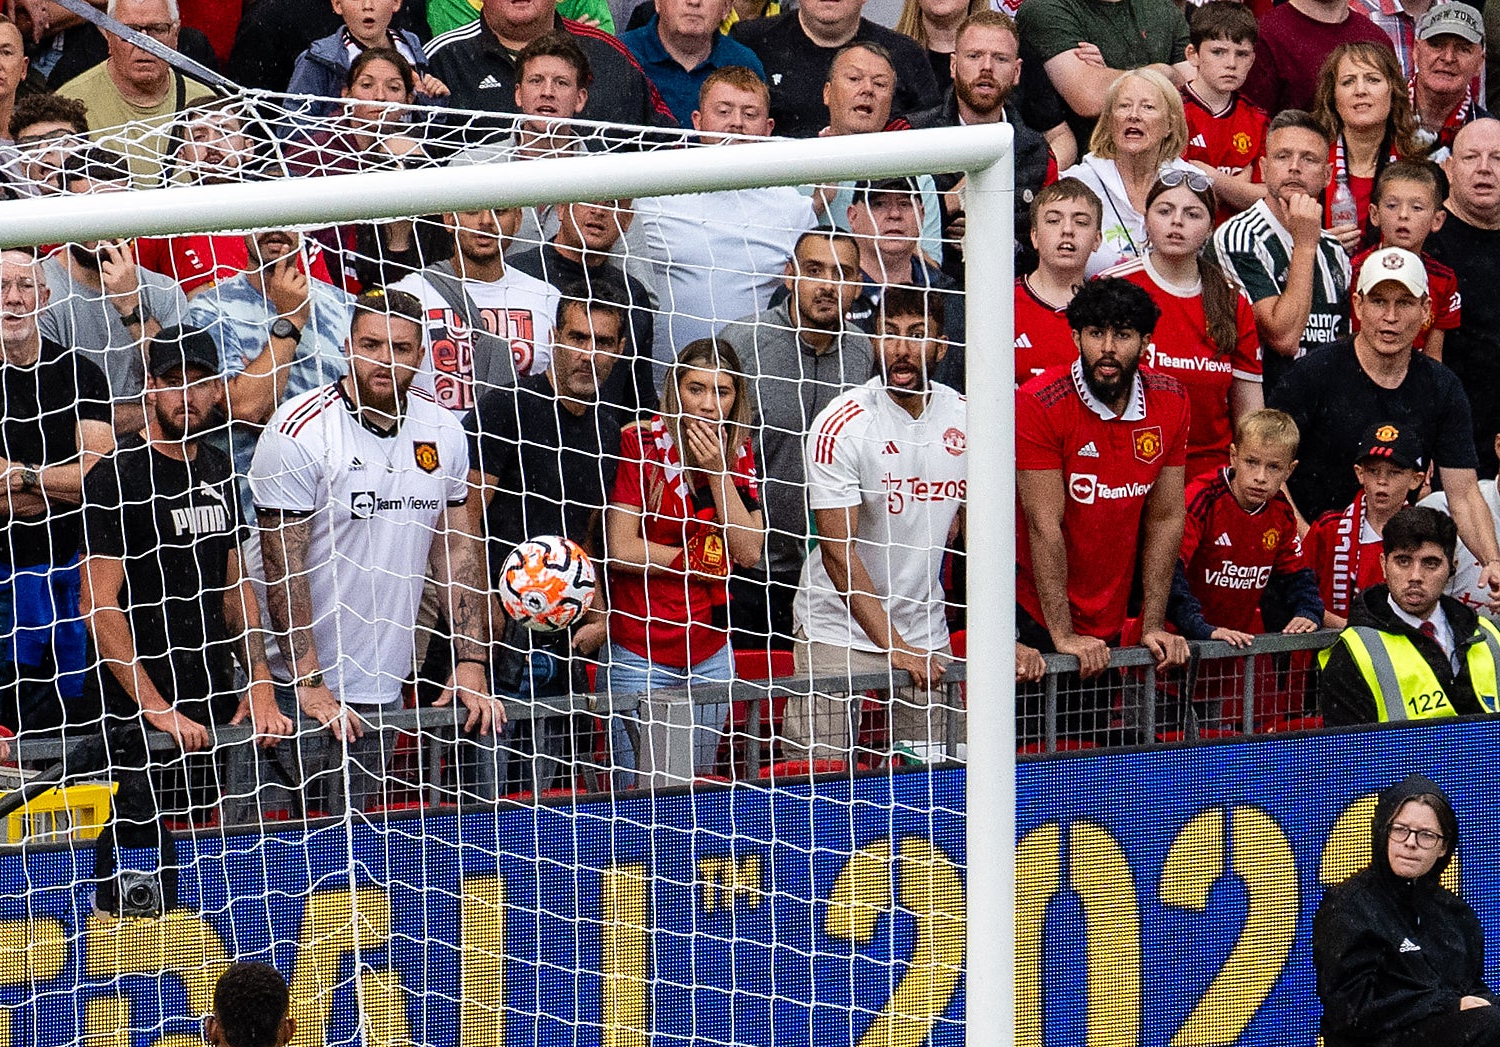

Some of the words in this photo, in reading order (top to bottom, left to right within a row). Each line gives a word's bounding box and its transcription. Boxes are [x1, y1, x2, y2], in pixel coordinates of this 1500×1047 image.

[1430, 9, 1452, 25] NEW
[1453, 10, 1479, 31] YORK
[1156, 351, 1233, 374] TeamViewe
[906, 477, 967, 502] Tezos
[1096, 480, 1153, 501] TeamView
[376, 497, 440, 511] TeamViewer
[170, 504, 227, 537] PUMA
[1204, 568, 1257, 590] Viewer
[1222, 560, 1258, 579] Team
[1408, 690, 1447, 715] 122
